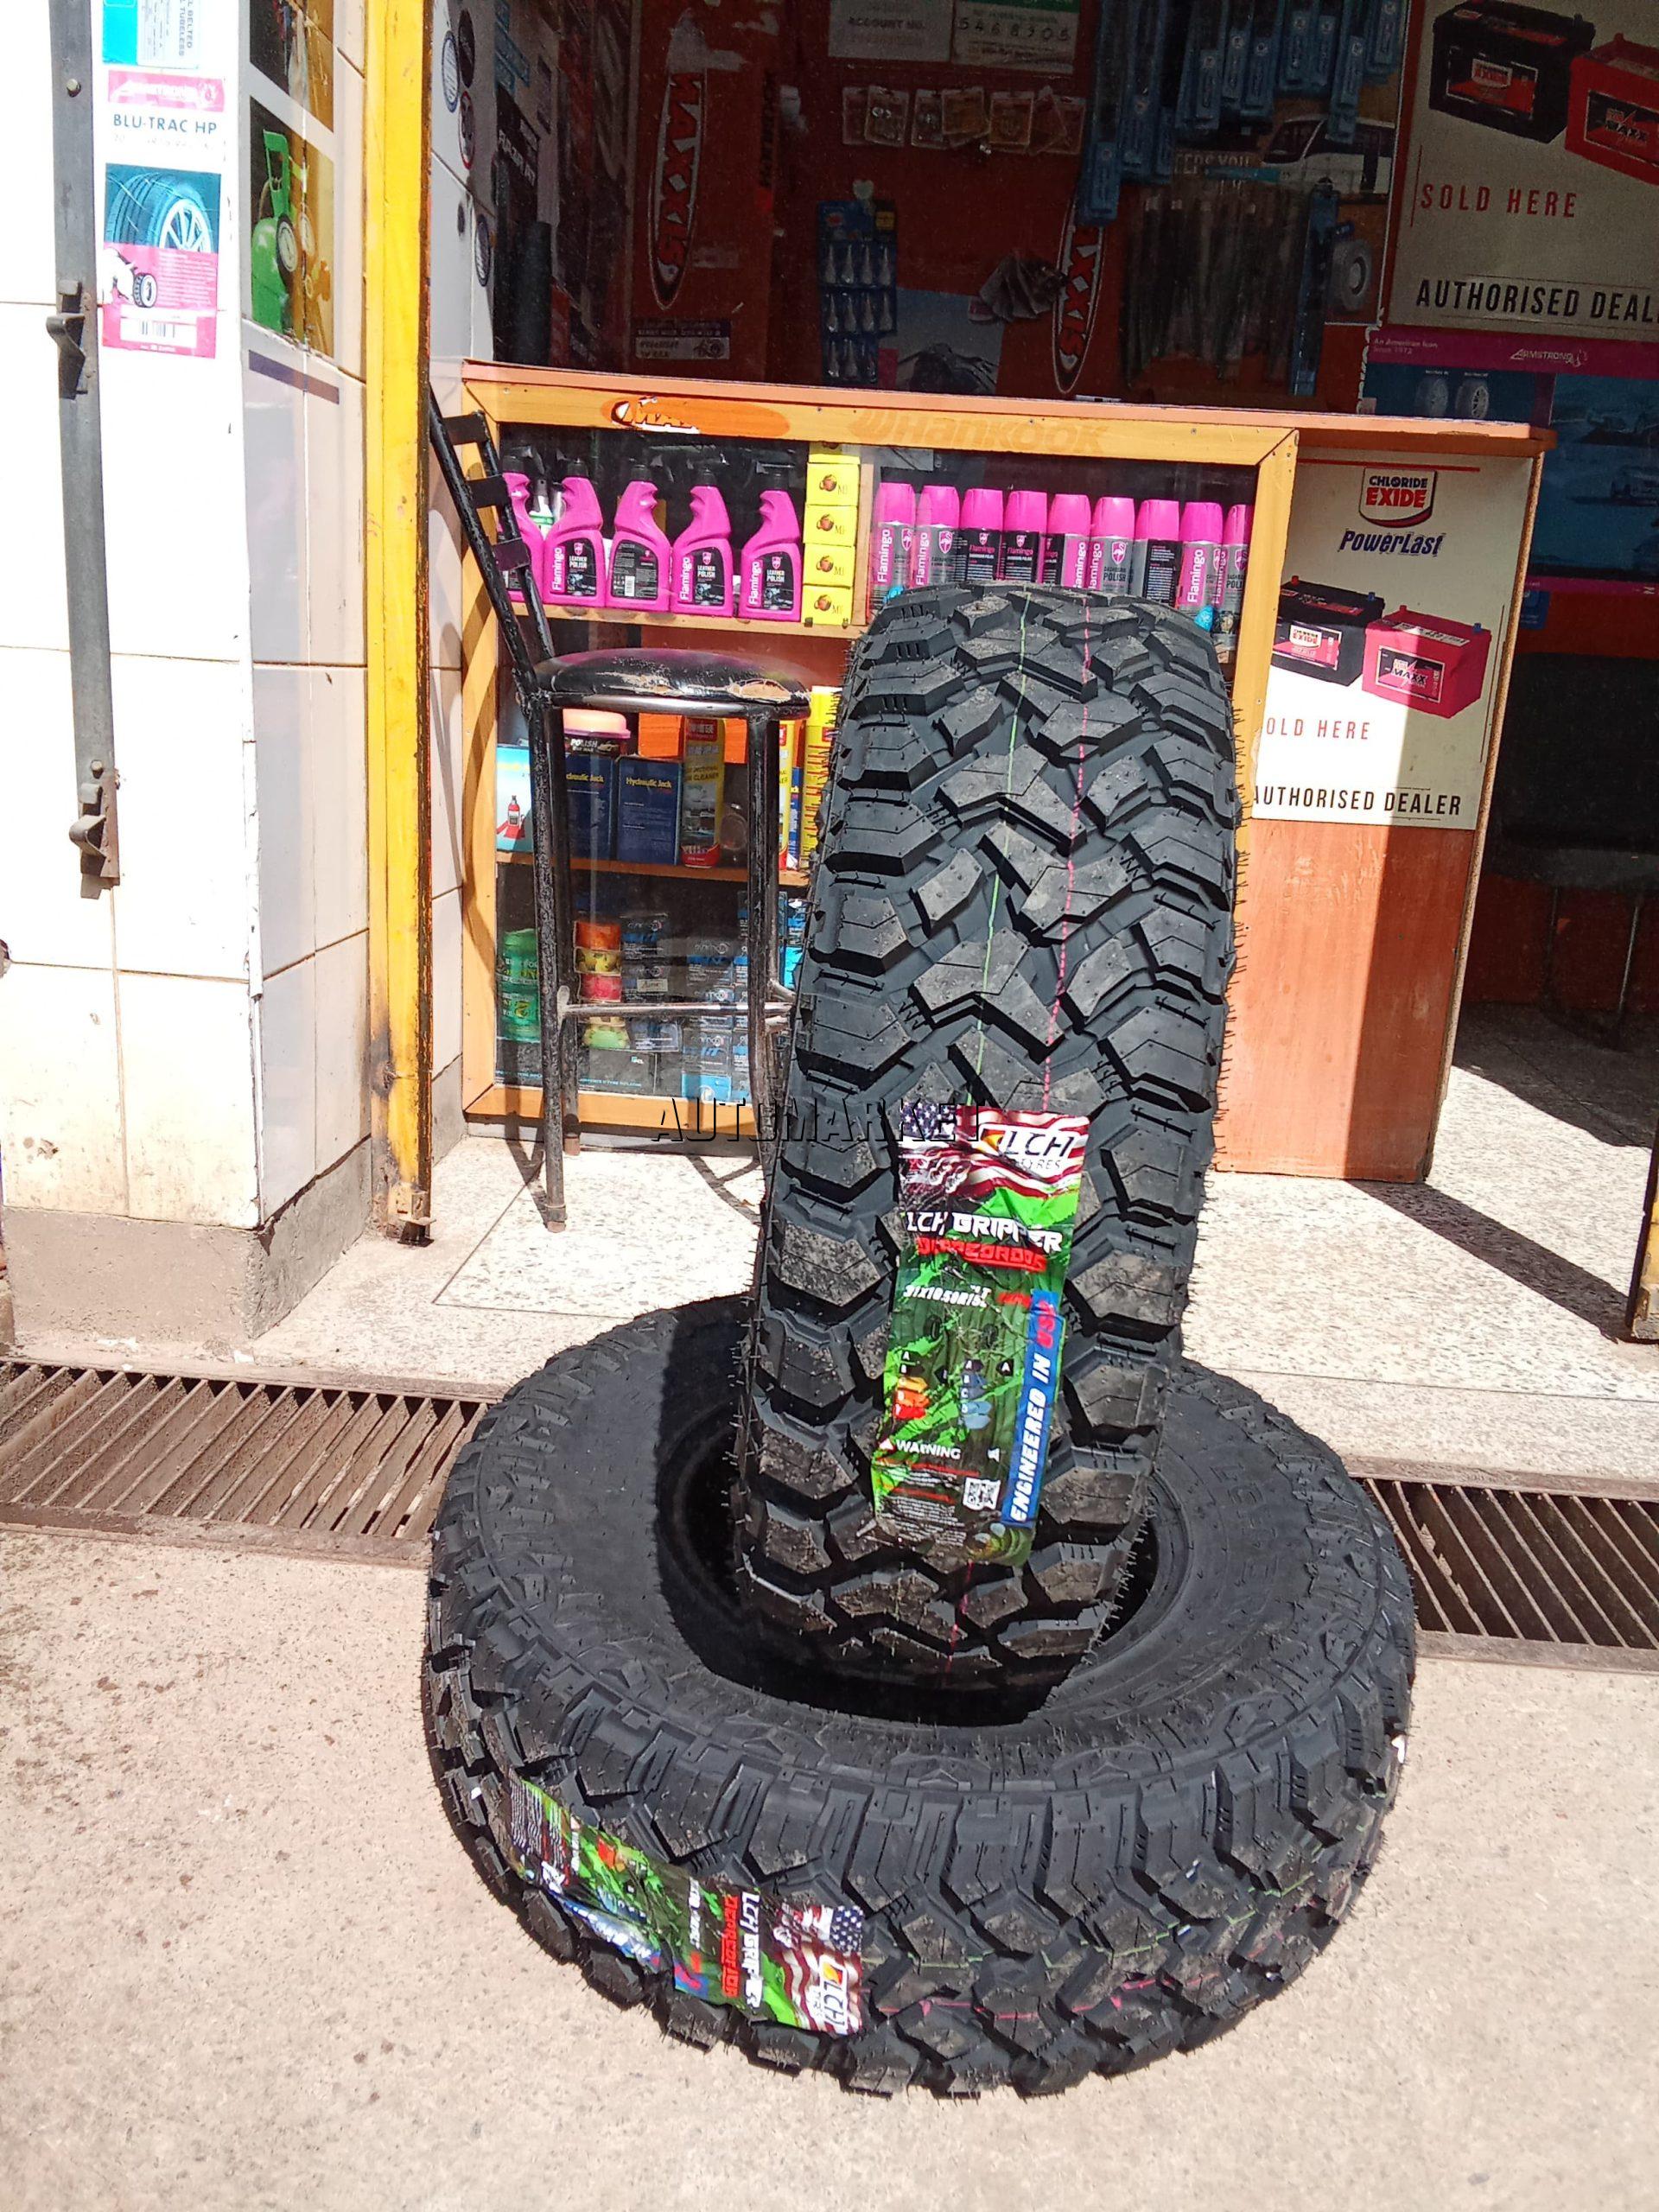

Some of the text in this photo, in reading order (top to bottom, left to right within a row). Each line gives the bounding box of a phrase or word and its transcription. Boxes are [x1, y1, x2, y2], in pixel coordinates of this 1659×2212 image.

[849, 16, 905, 29] ACCOUNT
[195, 121, 218, 135] HP
[1421, 183, 1577, 218] SOLD HERE
[1416, 279, 1579, 318] AUTHORISED
[1510, 347, 1574, 364] ARMSTRONG
[1369, 475, 1428, 490] CHLORIDE
[1365, 486, 1427, 509] EXIDE
[569, 561, 588, 569] POLISH
[876, 529, 893, 583] Flamingo
[916, 531, 931, 586] Flamingo
[1073, 542, 1087, 588] lamingo
[1088, 543, 1103, 590] lamingo
[551, 547, 565, 591] Flamingo
[679, 556, 693, 601] Flamingo
[696, 570, 716, 579] POLISH
[1103, 572, 1127, 582] POLISH
[1186, 549, 1206, 604] Flamingo
[748, 562, 762, 605] Flamingo
[1392, 668, 1427, 685] MAXX
[1266, 718, 1370, 741] OLD HERE
[570, 738, 599, 748] POLISH
[566, 772, 589, 782] draulic
[626, 776, 672, 790] Hydraulic Jack
[1384, 791, 1462, 817] DEALER
[1002, 1129, 1076, 1158] LCH
[906, 1211, 949, 1236] LCH
[1001, 1362, 1010, 1372] A
[1009, 1389, 1049, 1522] ENGINEERED
[1031, 1353, 1052, 1384] IN
[741, 1891, 760, 1932] LCH
[823, 1980, 845, 2024] LCH
